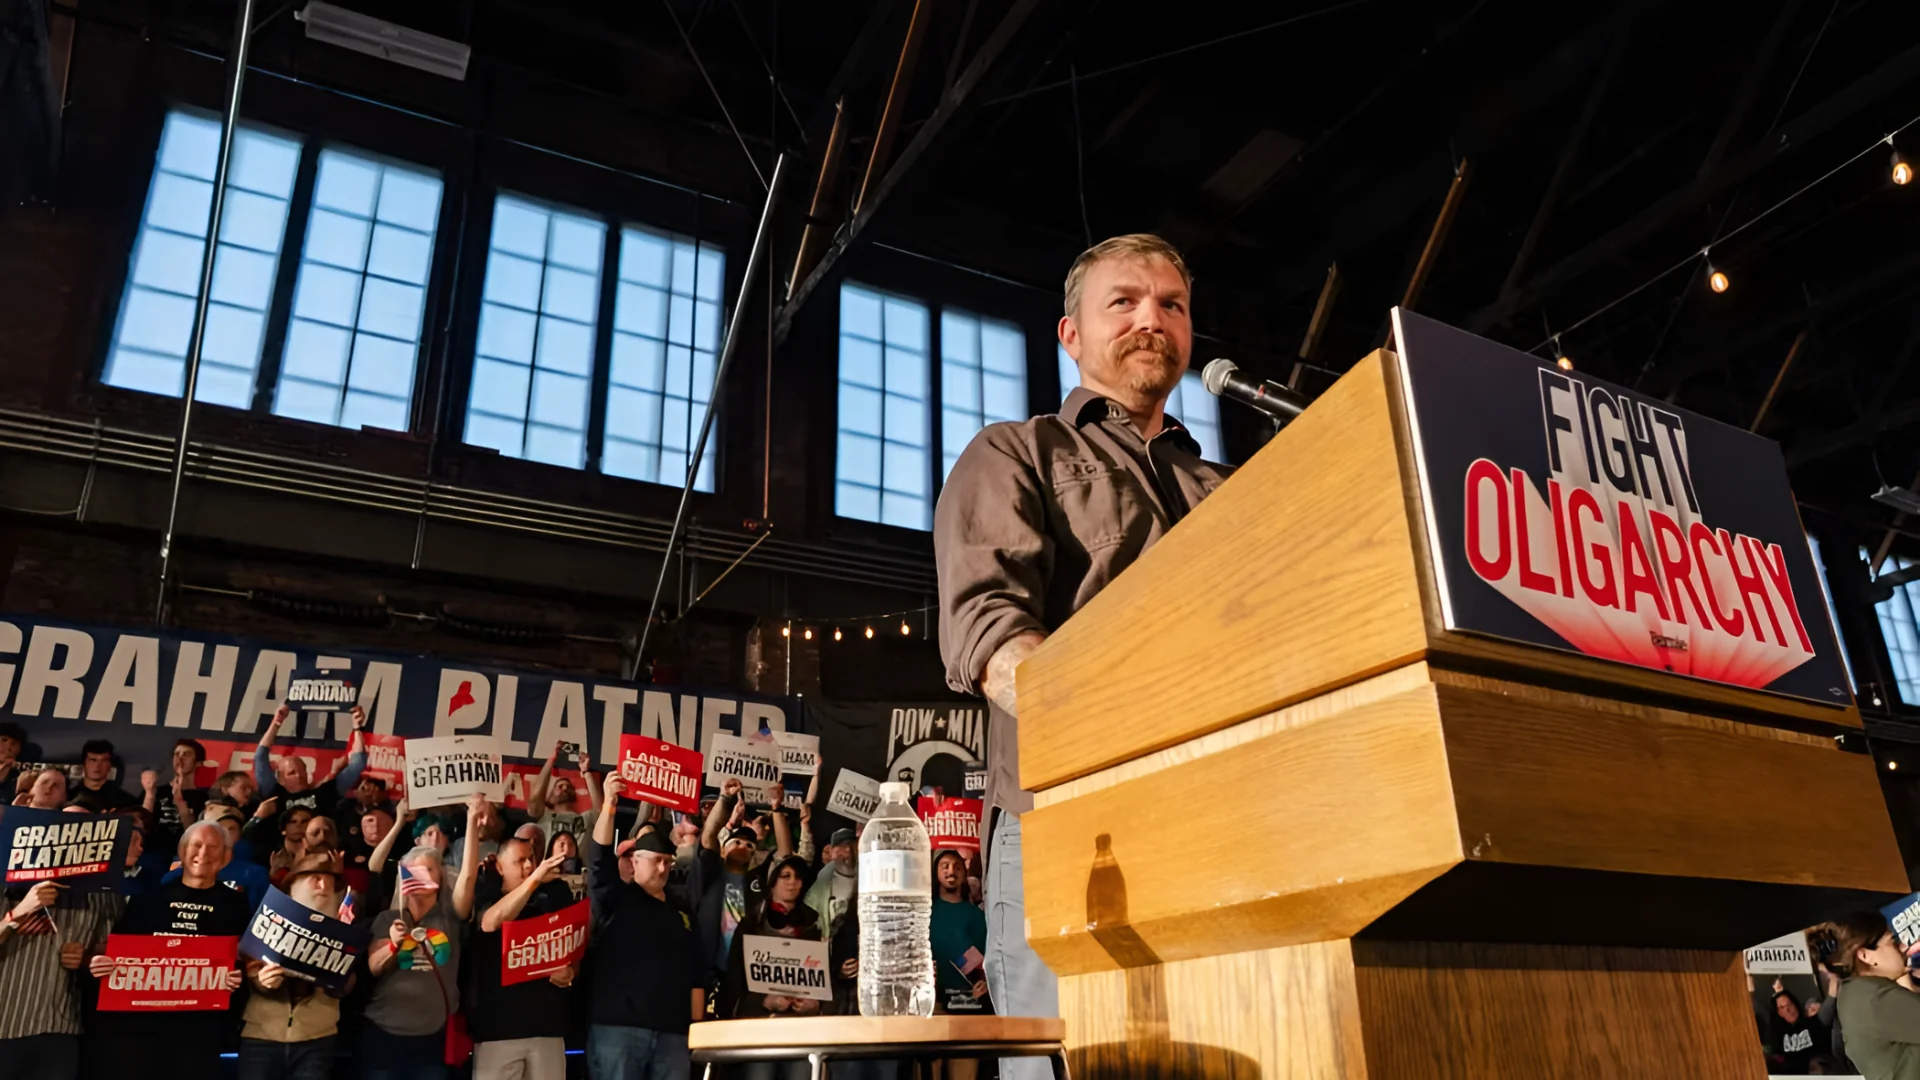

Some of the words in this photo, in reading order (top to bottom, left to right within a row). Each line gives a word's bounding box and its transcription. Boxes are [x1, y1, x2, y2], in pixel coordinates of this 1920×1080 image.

[1538, 367, 1702, 516] FIGHT
[1465, 458, 1816, 655] OLIGARCHY
[288, 685, 356, 702] GRAHAM
[886, 708, 935, 768] POW
[947, 709, 985, 761] MIA
[713, 756, 779, 782] GRAHAM
[782, 750, 815, 766] HAM
[413, 761, 499, 788] GRAHAM
[621, 760, 697, 799] GRAHAM
[12, 819, 119, 848] GRAHAM
[923, 817, 981, 838] GRAHA
[8, 841, 114, 870] PLATNER
[251, 913, 355, 976] GRAHAM
[508, 925, 585, 969] GRAHAM
[108, 966, 229, 991] GRAHAM
[750, 963, 826, 988] GRAHAM
